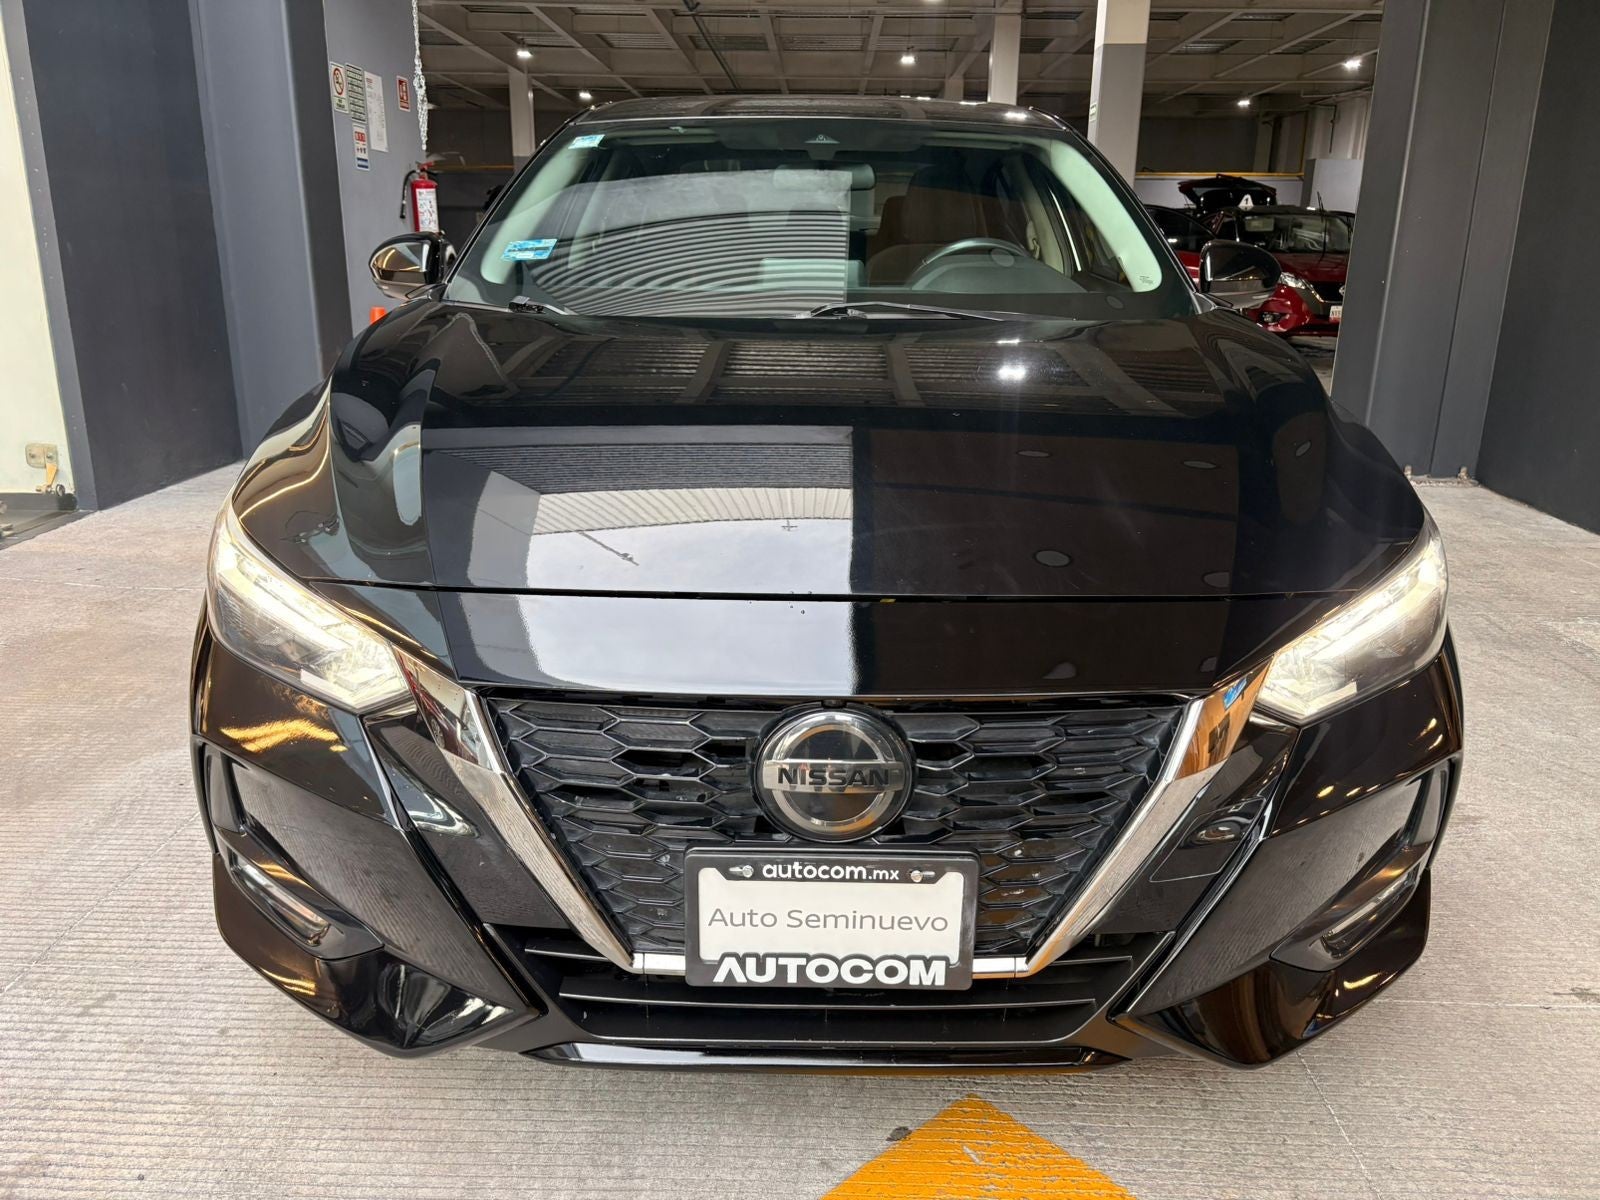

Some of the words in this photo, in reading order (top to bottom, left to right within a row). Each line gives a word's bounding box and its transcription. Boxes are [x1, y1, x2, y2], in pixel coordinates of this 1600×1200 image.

[777, 767, 889, 786] NISSAN
[762, 862, 899, 881] autocom.mx
[708, 908, 777, 928] Auto
[786, 909, 948, 932] Seminuevo
[713, 957, 946, 986] AUTOCOM
